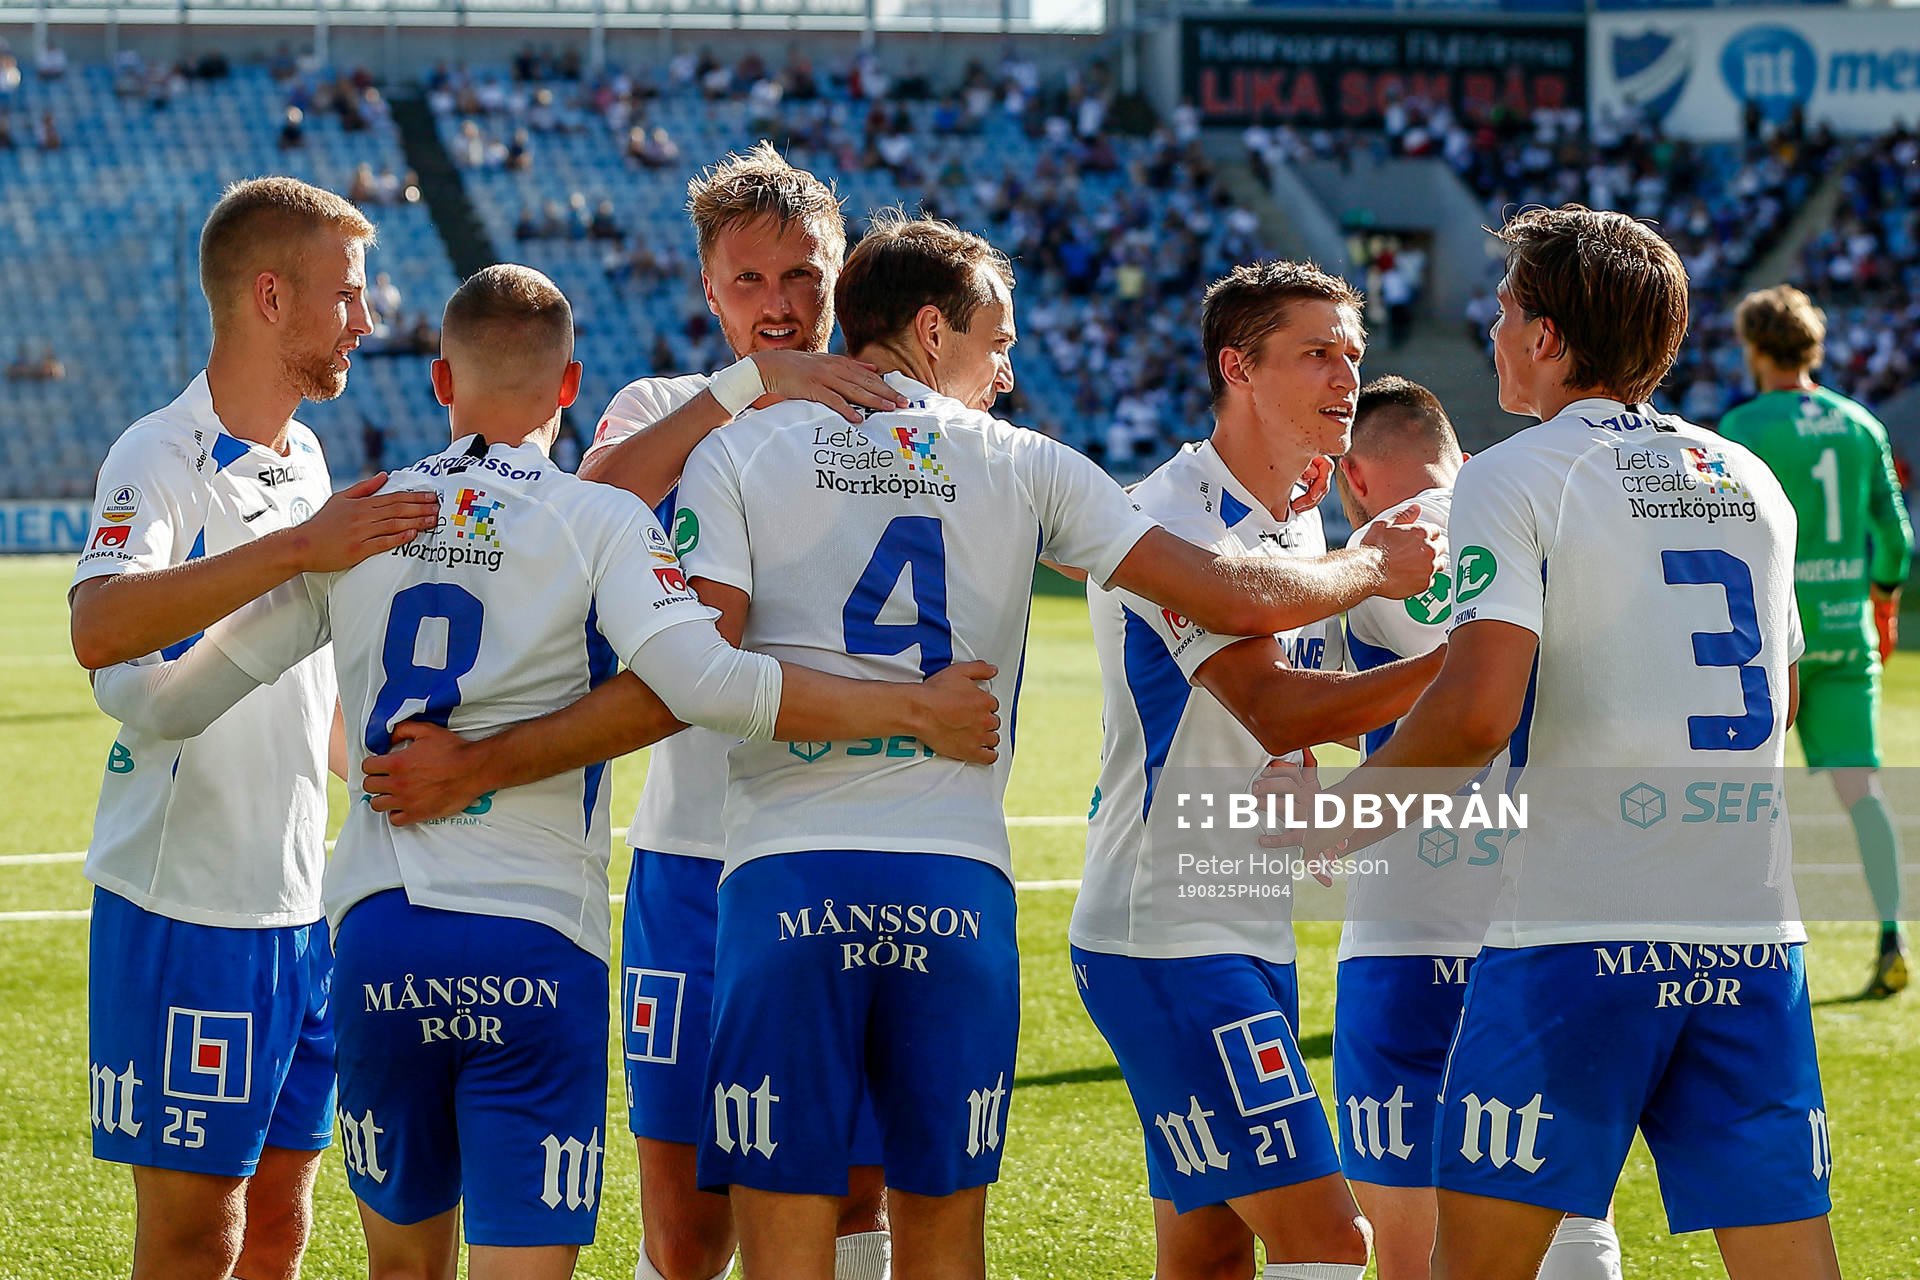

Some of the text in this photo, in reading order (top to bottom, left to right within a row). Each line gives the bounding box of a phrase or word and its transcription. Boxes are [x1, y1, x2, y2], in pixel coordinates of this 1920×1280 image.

[1201, 72, 1322, 113] LIKA
[813, 427, 868, 448] Let's
[814, 449, 893, 470] create
[1614, 448, 1670, 471] Let's
[816, 470, 956, 502] Norrköping
[1622, 473, 1696, 494] create
[1811, 448, 1844, 543] 1
[1629, 498, 1756, 523] Norrköping
[843, 516, 952, 683] 4
[365, 583, 484, 757] 8
[1660, 549, 1774, 750] 3
[778, 899, 981, 941] MÅNSSON
[840, 935, 929, 973] RÖR
[1596, 940, 1791, 977] MÅNSSON
[363, 974, 560, 1013] MÅNSSON
[1655, 972, 1742, 1009] RÖR
[420, 1007, 504, 1045] RÖR
[90, 1060, 143, 1138] nt
[714, 1074, 780, 1160] nt
[966, 1071, 1006, 1159] nt
[162, 1105, 207, 1149] 25
[338, 1105, 388, 1184] nt
[1155, 1095, 1231, 1177] nt
[1249, 1118, 1298, 1167] 21
[1346, 1085, 1415, 1161] nt
[1460, 1093, 1554, 1175] nt
[540, 1126, 604, 1212] nt
